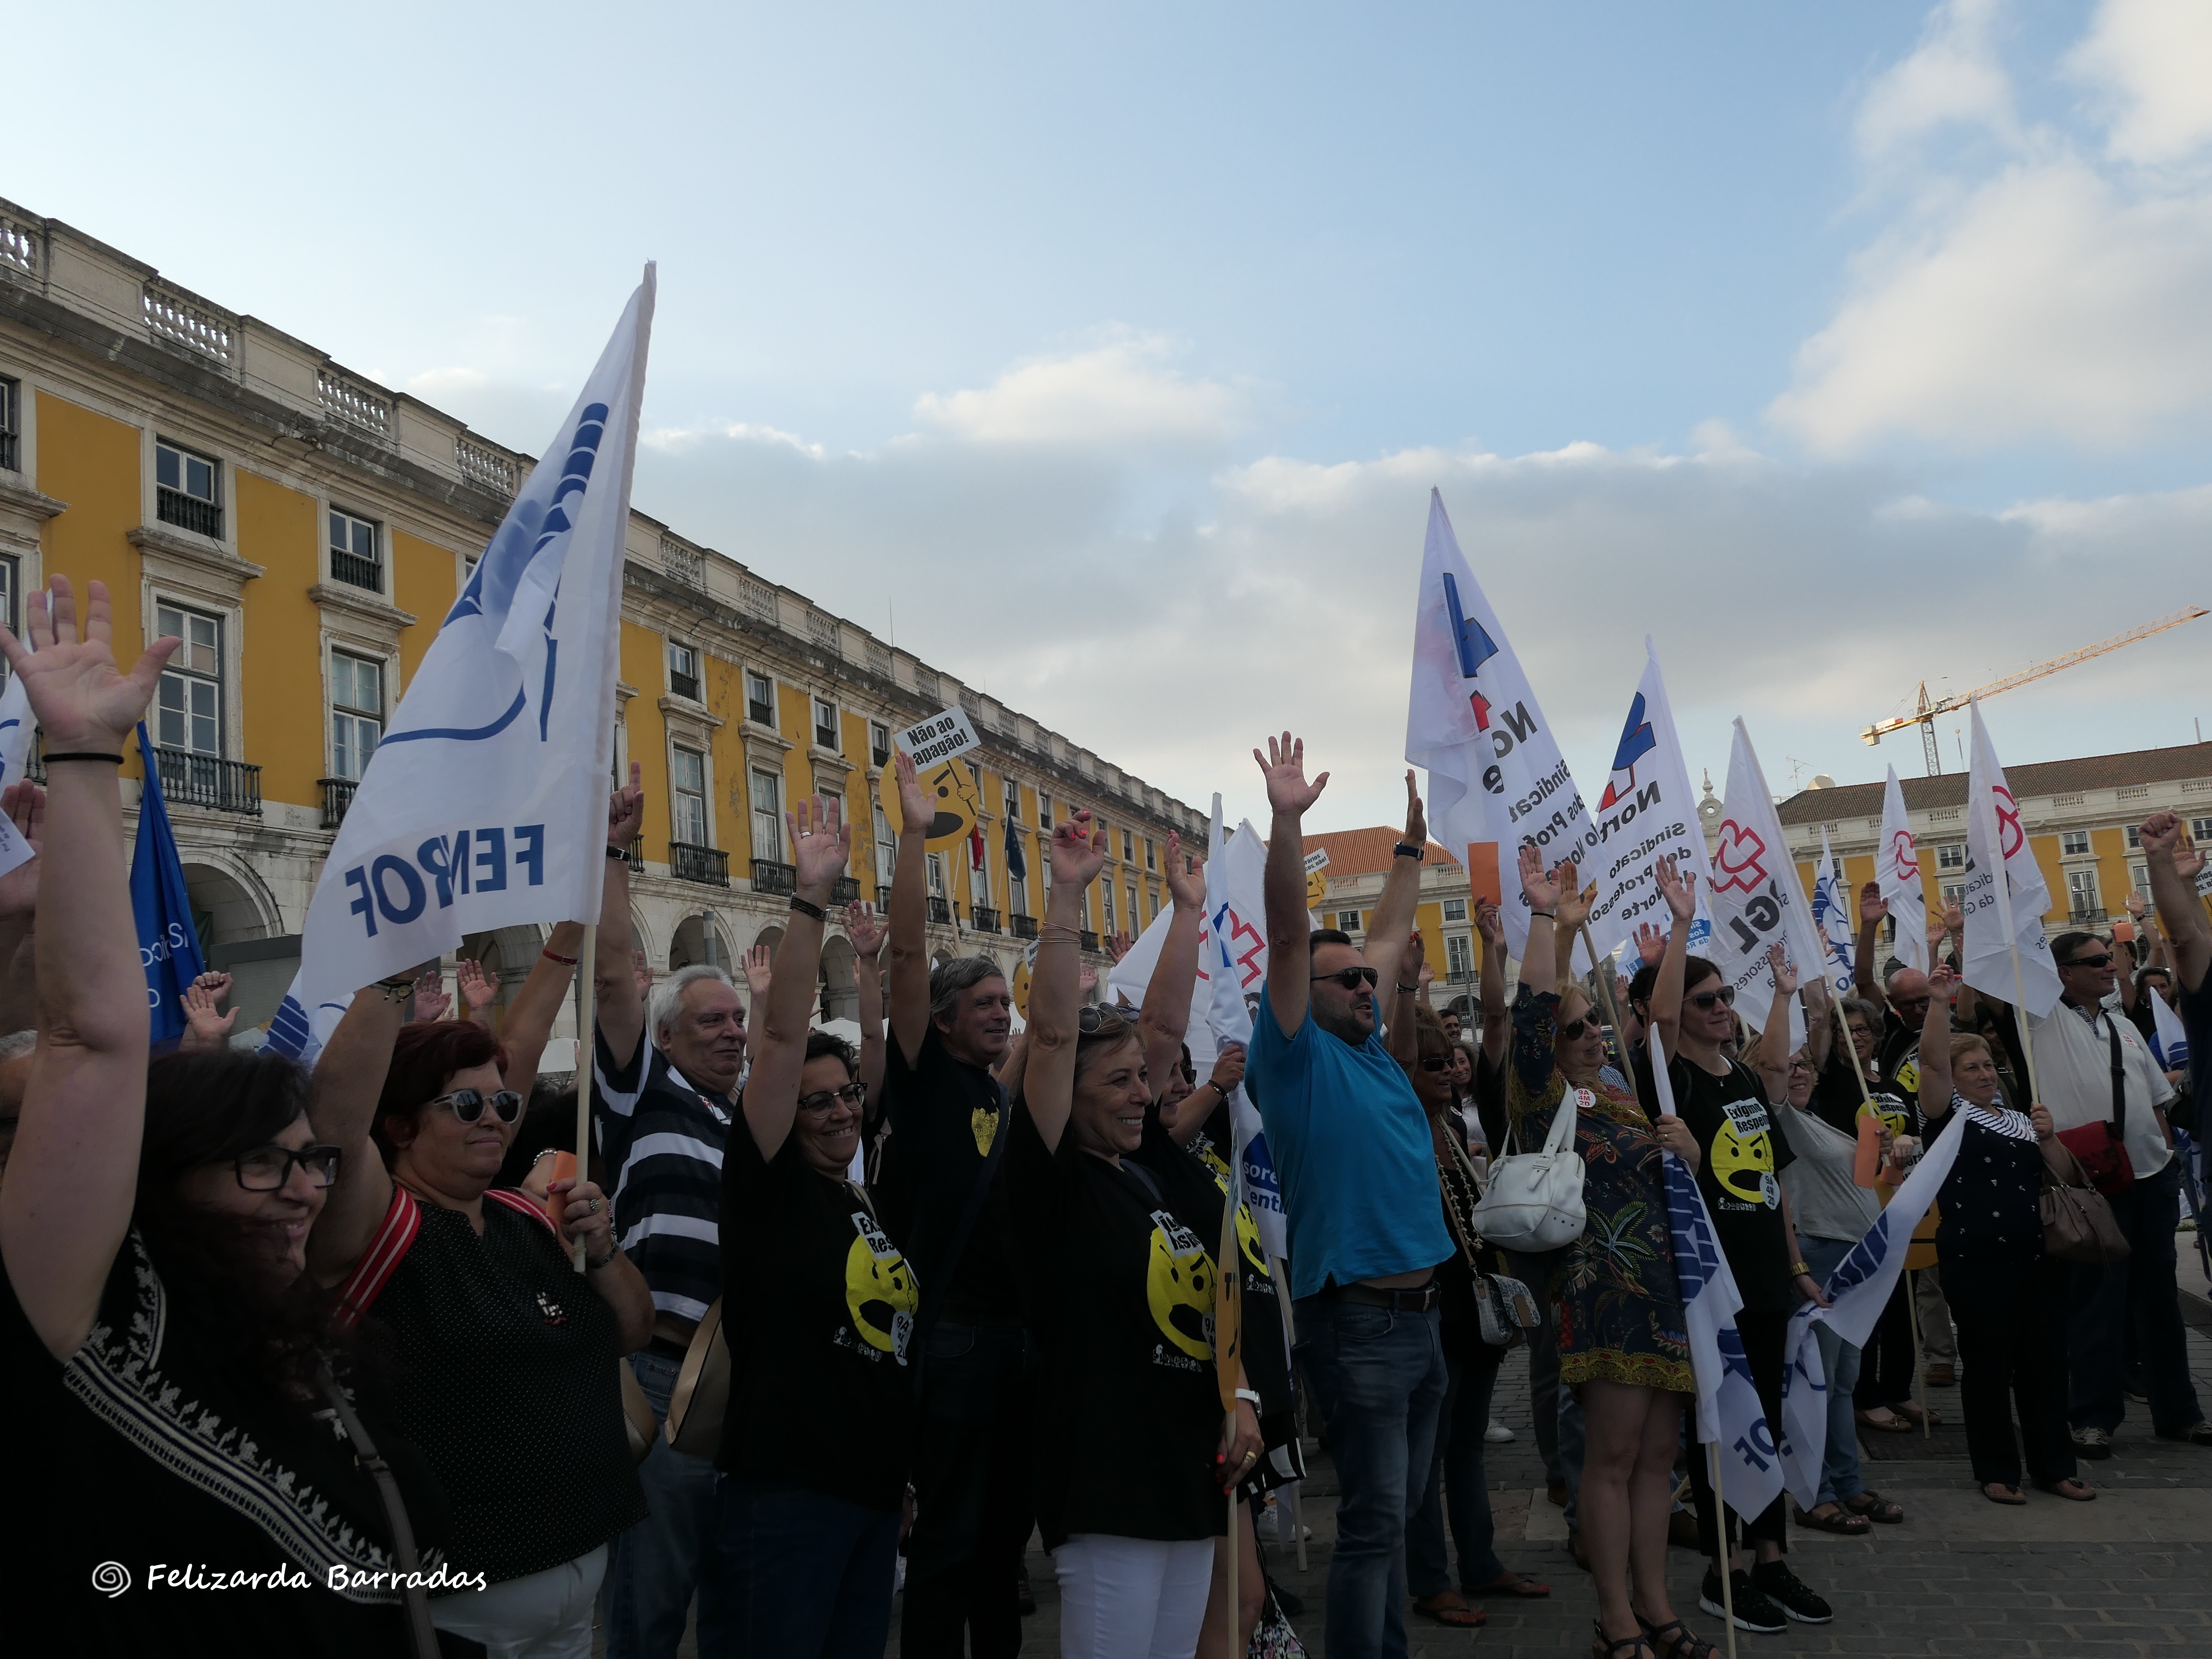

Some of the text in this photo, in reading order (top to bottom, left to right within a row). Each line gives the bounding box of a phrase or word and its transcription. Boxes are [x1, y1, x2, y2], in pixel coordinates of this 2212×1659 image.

[907, 717, 955, 746] Não ao
[912, 728, 970, 766] apagão!
[1304, 854, 1321, 865] rários
